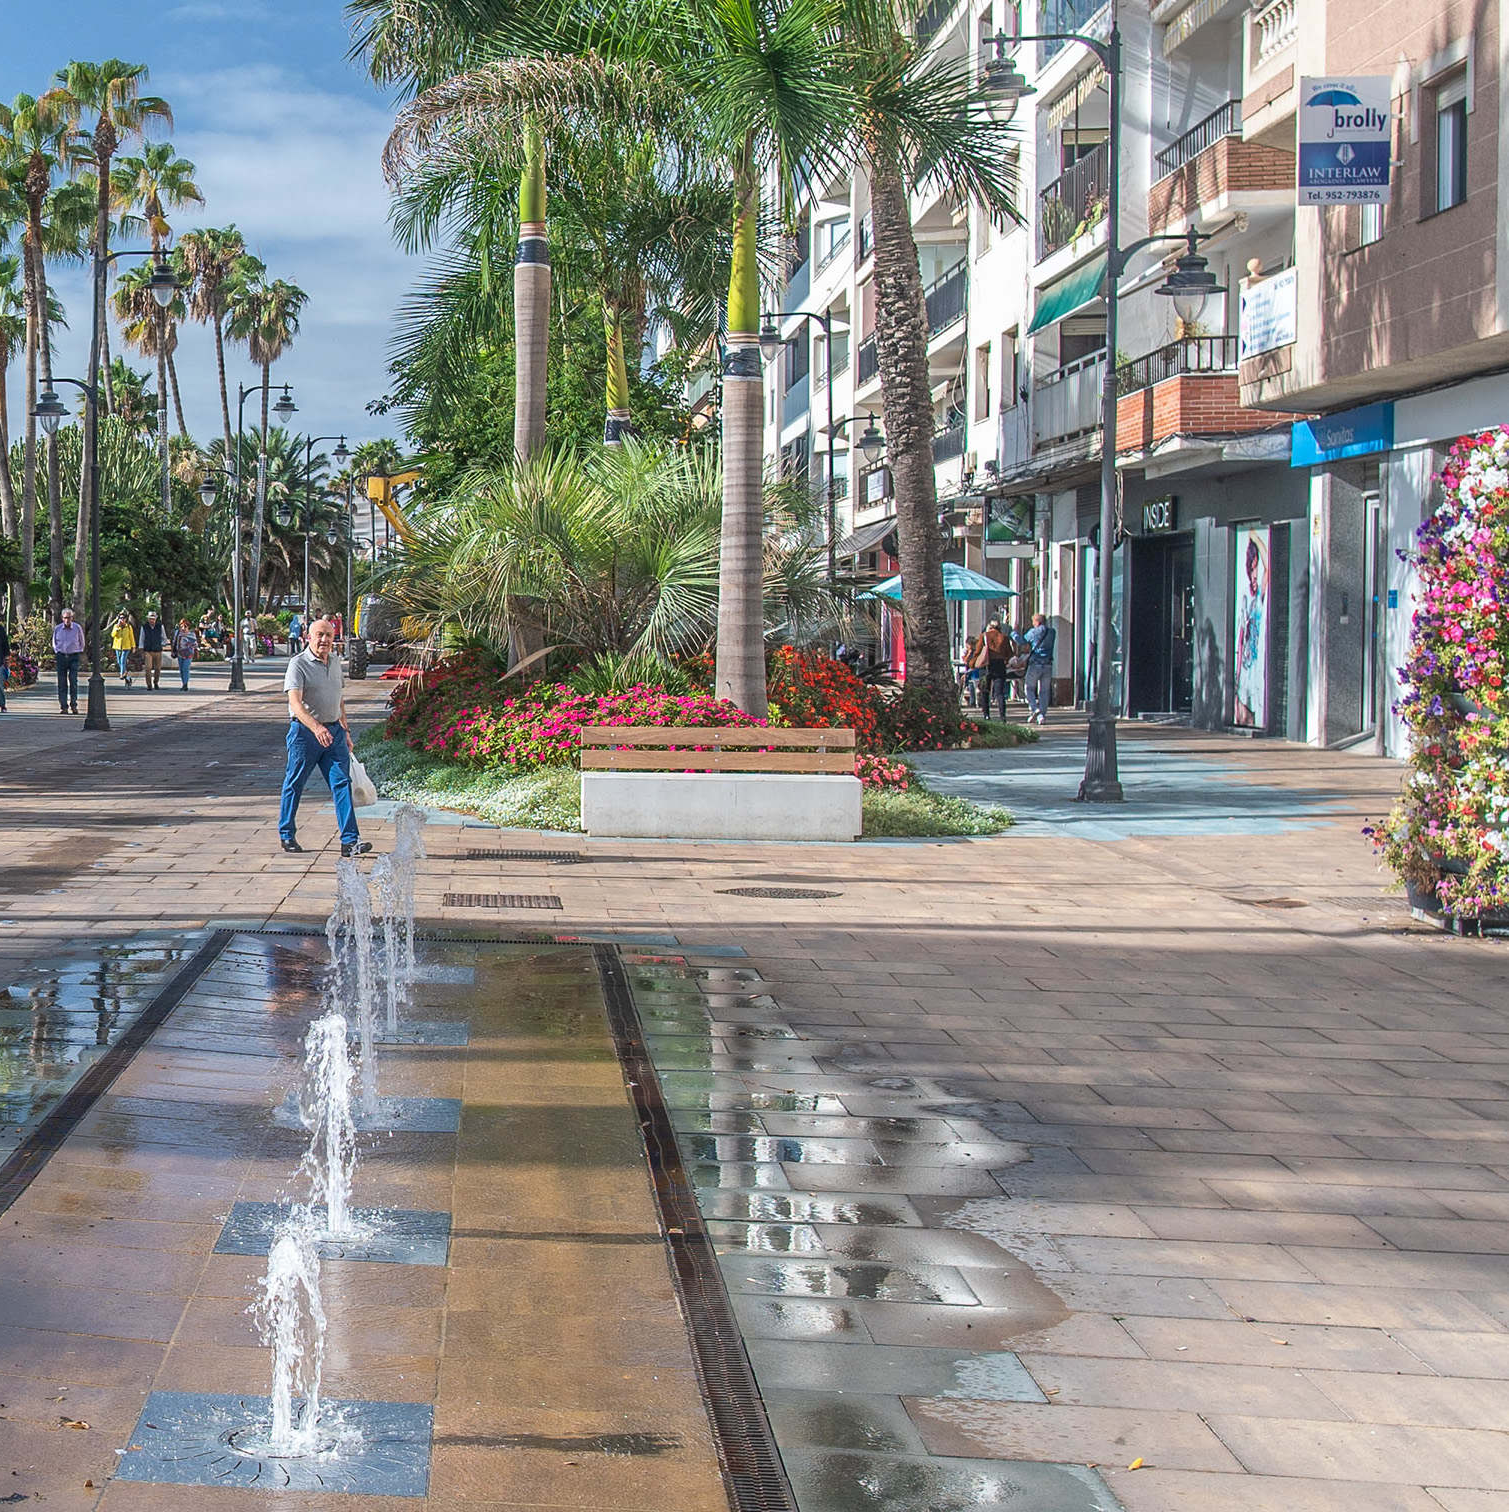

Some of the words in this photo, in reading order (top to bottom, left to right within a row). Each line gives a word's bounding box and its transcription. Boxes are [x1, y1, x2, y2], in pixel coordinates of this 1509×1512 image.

[1334, 108, 1387, 132] brolly
[1309, 166, 1382, 179] INTERLAW
[1308, 177, 1347, 185] ABOGADOS
[1307, 191, 1323, 200] Tel.
[1325, 190, 1380, 200] 952-793876
[1326, 427, 1354, 446] Sanitas
[1143, 501, 1170, 530] INSIDE
